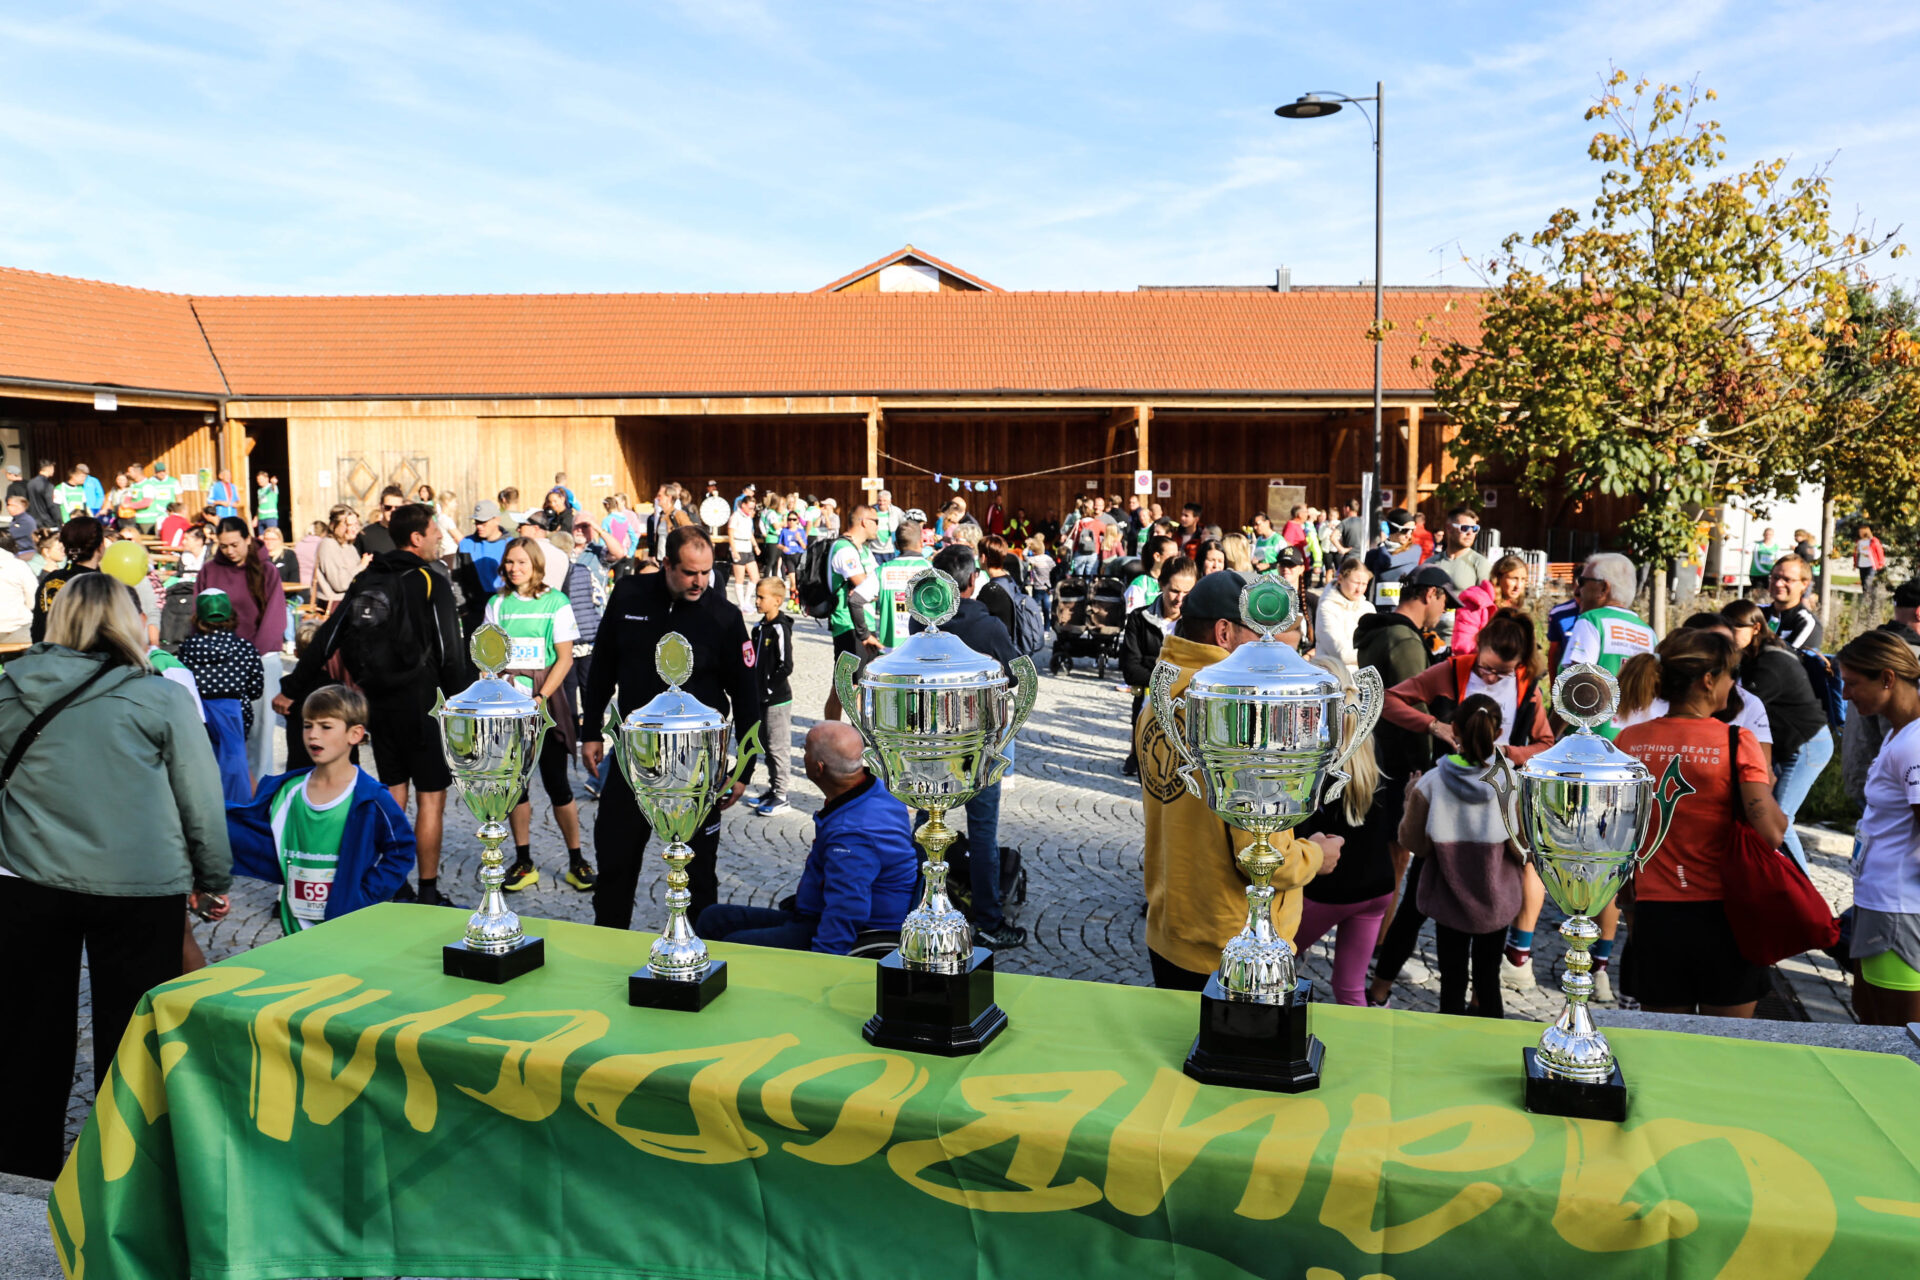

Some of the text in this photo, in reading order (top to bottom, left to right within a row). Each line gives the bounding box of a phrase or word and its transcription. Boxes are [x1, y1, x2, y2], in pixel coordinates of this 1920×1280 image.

[1611, 626, 1649, 646] ESB
[1630, 744, 1721, 756] NOTHING BEATS
[1634, 753, 1652, 762] HE
[304, 883, 327, 901] 69
